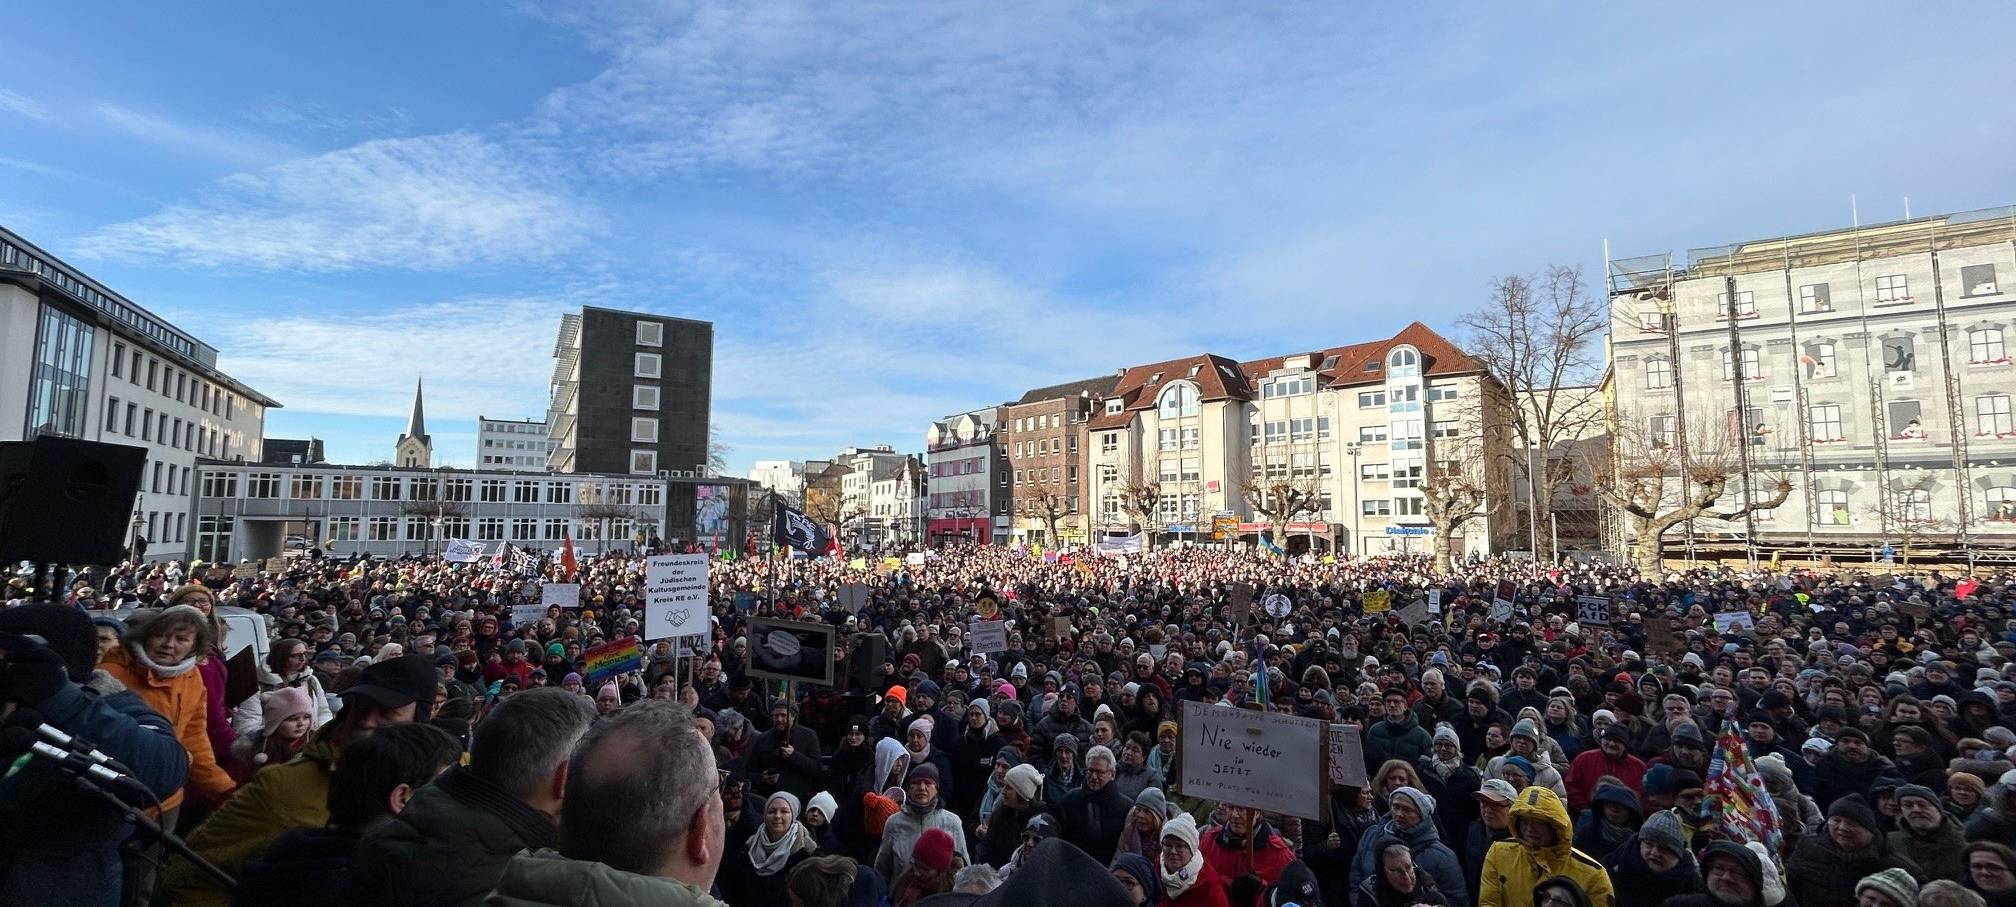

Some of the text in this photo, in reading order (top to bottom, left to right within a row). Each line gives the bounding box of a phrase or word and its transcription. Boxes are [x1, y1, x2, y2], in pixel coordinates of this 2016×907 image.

[1386, 527, 1429, 536] Diakonie
[660, 576, 696, 584] Jüdischen
[648, 584, 706, 594] Kultusgemeinde
[1578, 602, 1608, 613] FCK
[1579, 610, 1609, 621] AfD
[1200, 722, 1282, 759] Nie wieder
[1329, 730, 1343, 743] TIE
[1213, 764, 1253, 777] JETZT
[1189, 777, 1212, 787] KEIN
